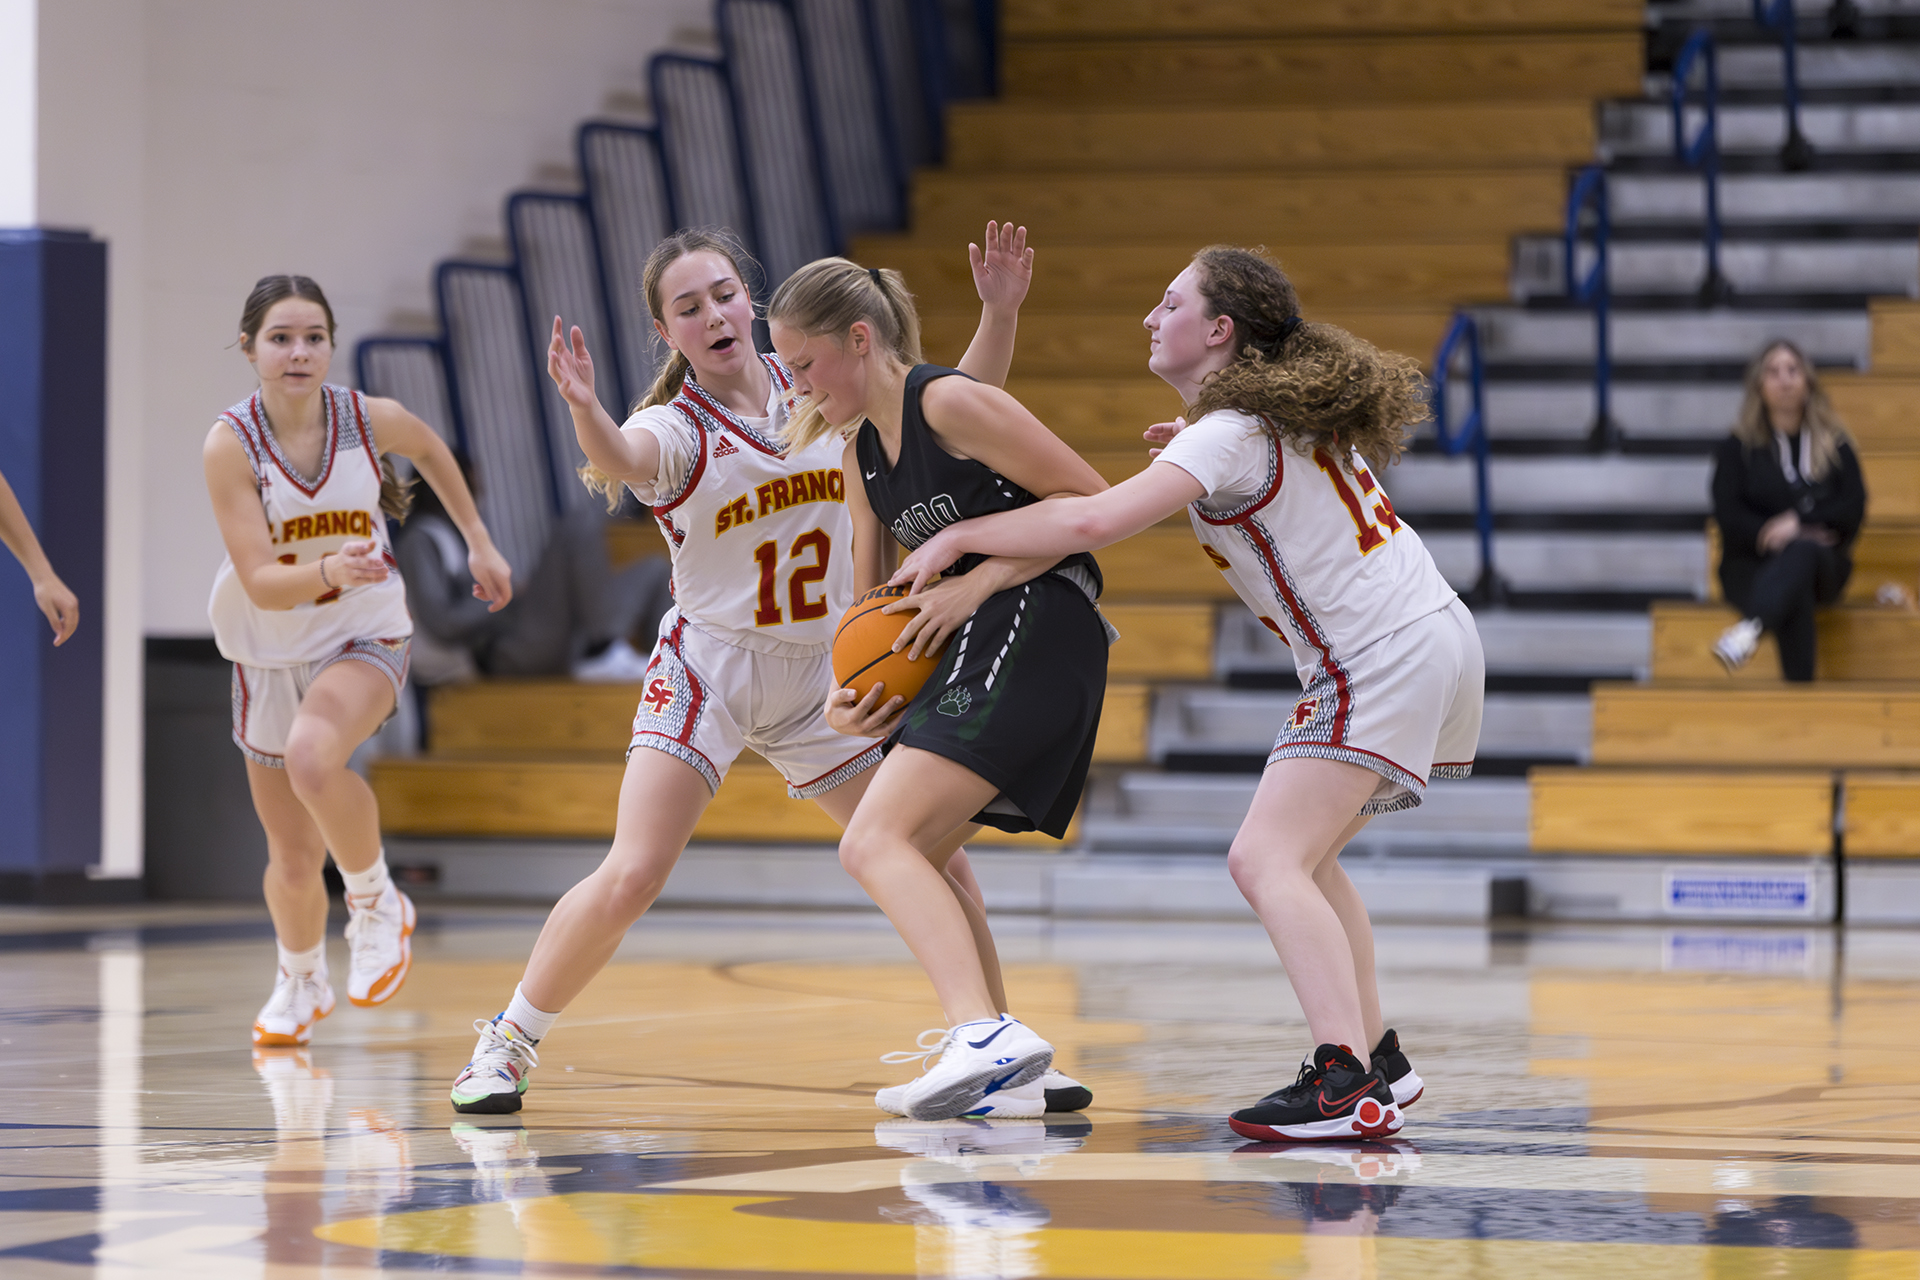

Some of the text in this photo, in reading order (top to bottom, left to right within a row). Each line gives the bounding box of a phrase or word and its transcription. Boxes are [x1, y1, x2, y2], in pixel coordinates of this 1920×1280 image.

[713, 446, 739, 458] adidas
[715, 492, 755, 540] ST.
[754, 527, 832, 627] 12
[644, 676, 676, 717] SF
